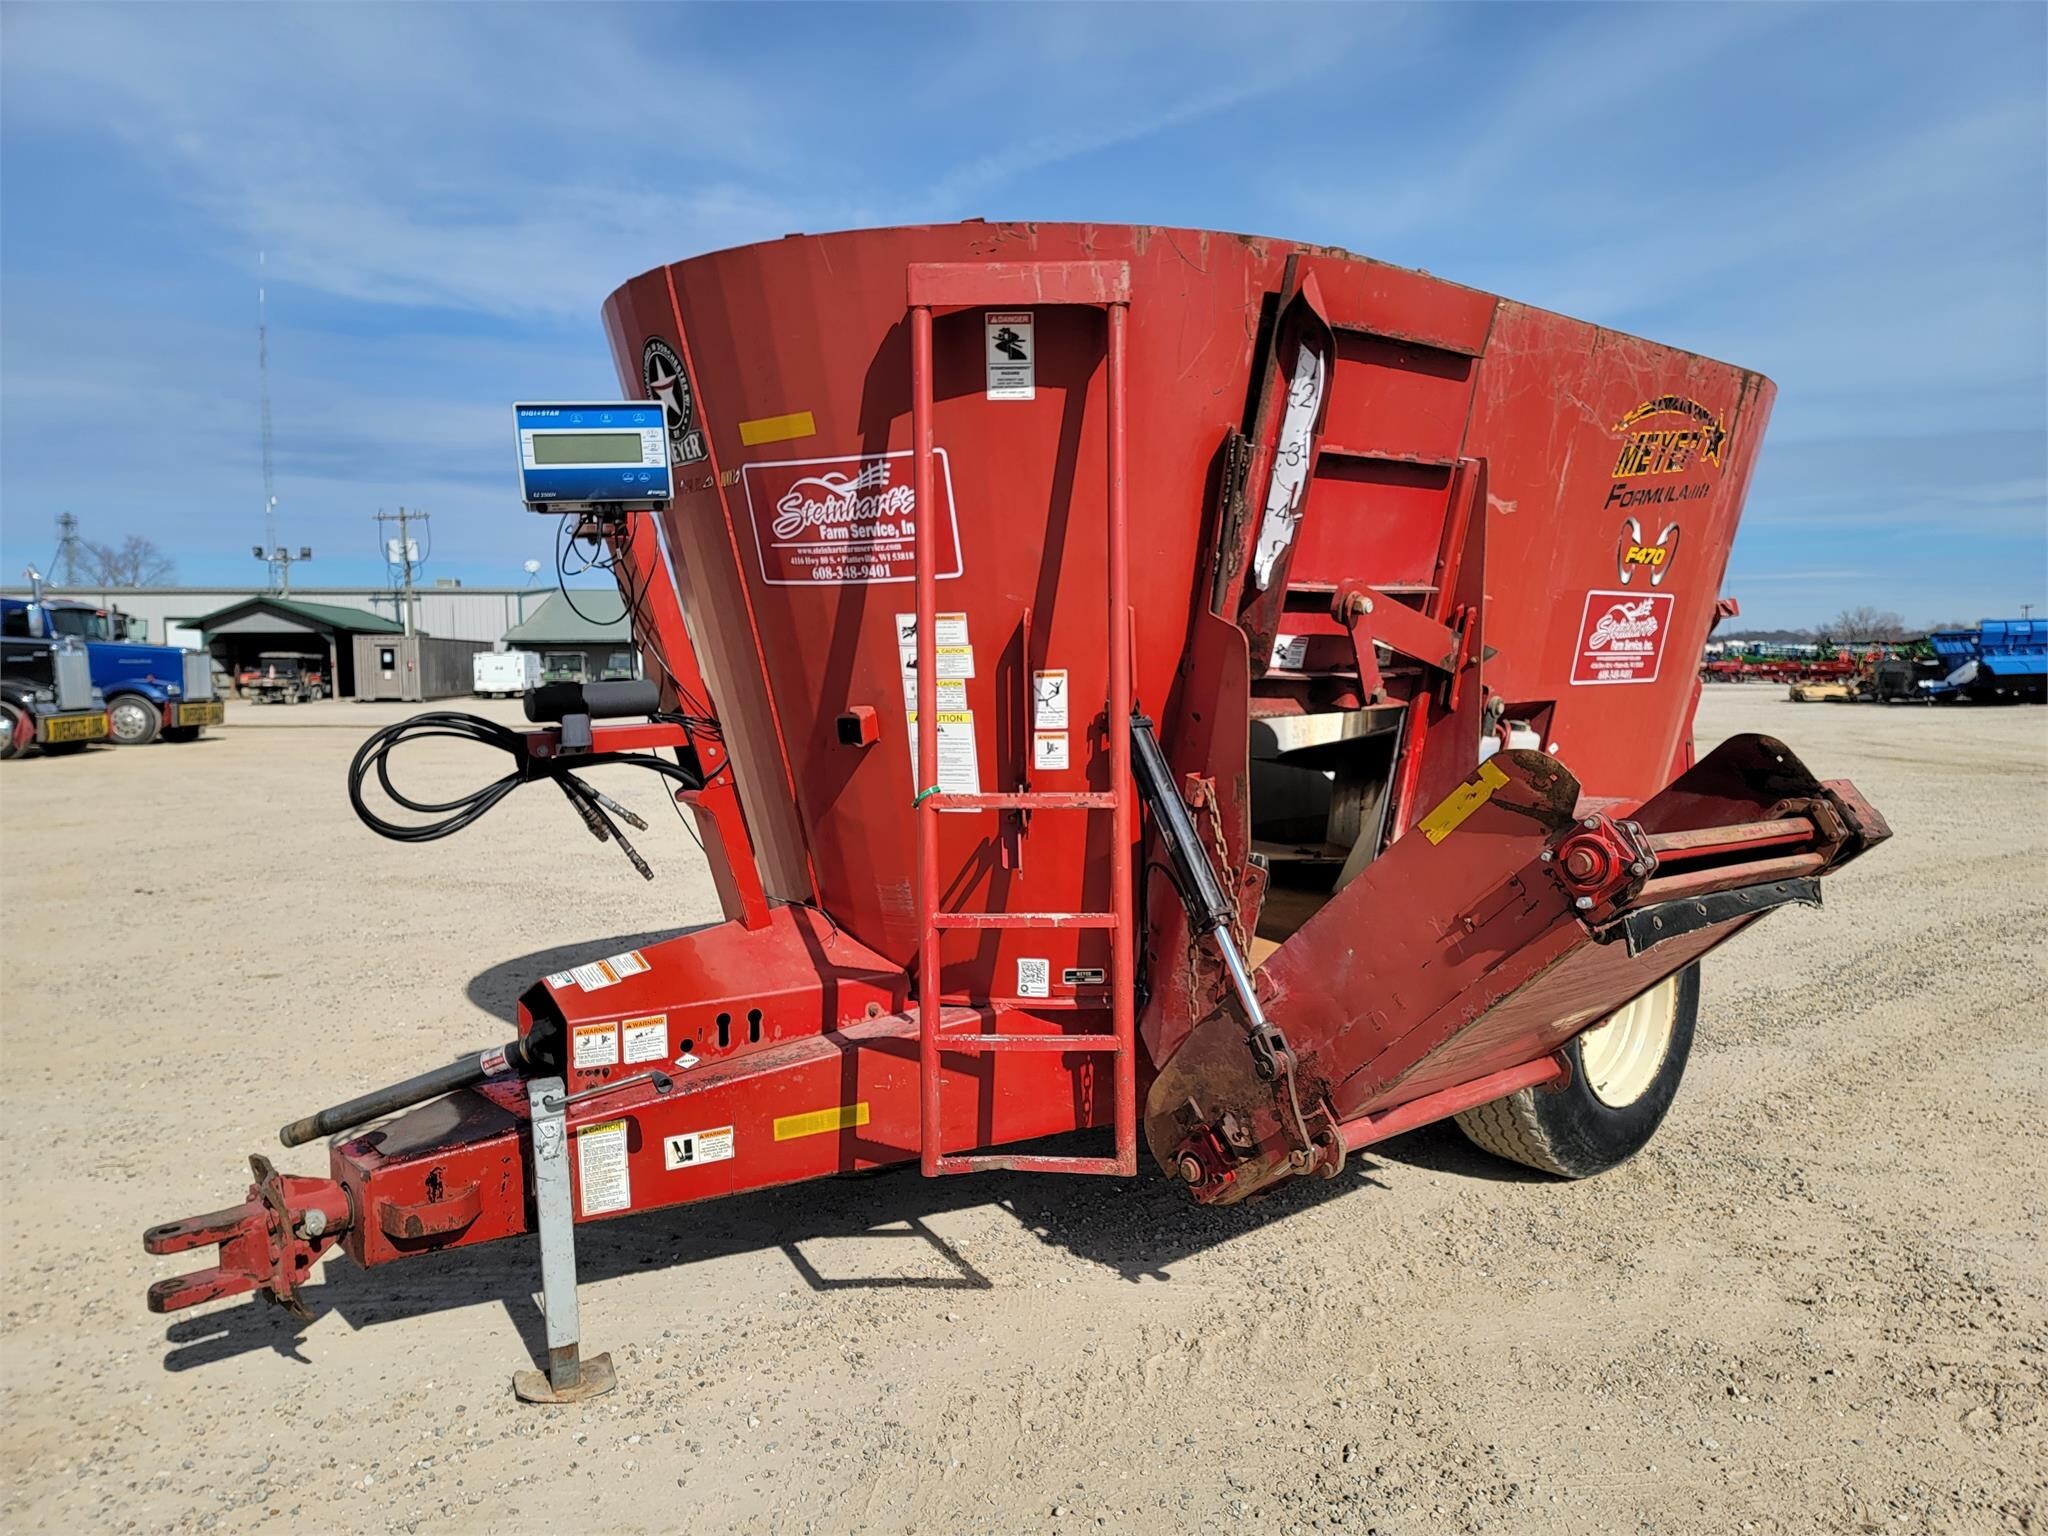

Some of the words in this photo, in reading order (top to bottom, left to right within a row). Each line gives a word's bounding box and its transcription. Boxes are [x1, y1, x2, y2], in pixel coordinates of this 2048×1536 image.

[1299, 382, 1316, 408] 2
[671, 433, 702, 465] EYER
[1285, 441, 1300, 467] 3
[820, 524, 849, 540] Farm
[851, 521, 900, 538] Service,
[901, 519, 915, 535] In
[1625, 546, 1666, 565] F470
[812, 564, 891, 579] 608-348-9401
[937, 714, 964, 722] UTION
[583, 1025, 615, 1035] WARNING
[633, 1018, 664, 1028] WARNING
[589, 1121, 620, 1133] CAUTION
[704, 1128, 732, 1139] WARNING
